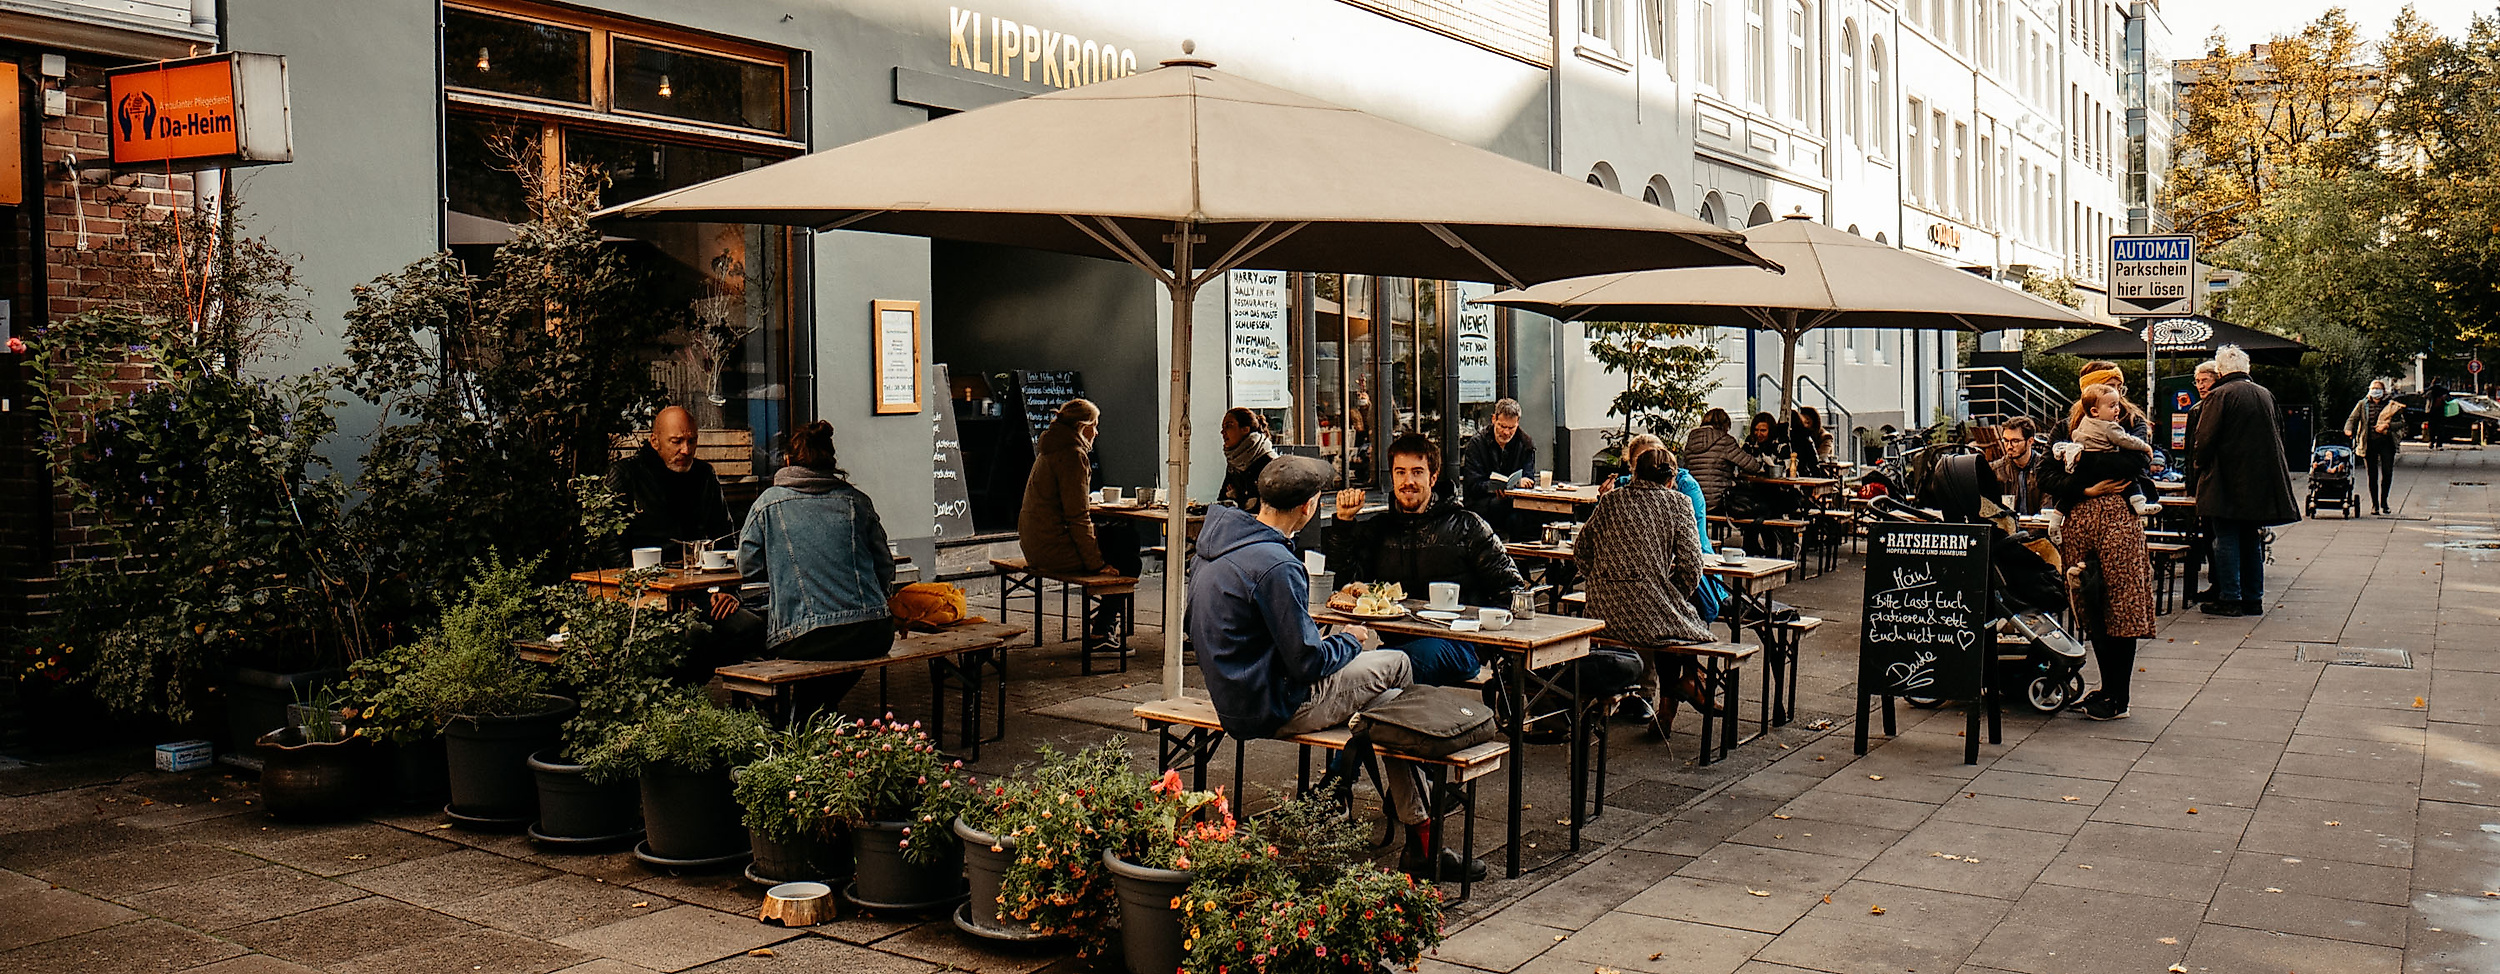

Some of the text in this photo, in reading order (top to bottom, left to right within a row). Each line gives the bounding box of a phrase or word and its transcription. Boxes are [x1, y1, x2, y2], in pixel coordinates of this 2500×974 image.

[160, 109, 231, 138] Da-Heim
[2116, 241, 2187, 259] AUTOMAT
[2116, 262, 2187, 276] Parkschein
[1234, 272, 1258, 284] HARRY
[1235, 286, 1254, 296] SALLY
[2117, 282, 2184, 296] hier lösen
[1460, 314, 1489, 334] NEVER
[1460, 342, 1487, 353] MET YOUR
[1235, 358, 1281, 370] ORGASMUS.
[1460, 355, 1489, 367] MOTHER
[1887, 533, 1969, 549] RATSHERRN
[1893, 561, 1933, 589] Moin!
[1870, 594, 1902, 609] Bitte
[1935, 591, 1972, 613] Euch
[1869, 625, 1954, 644] Euch nicht um
[1886, 651, 1937, 687] Danke
